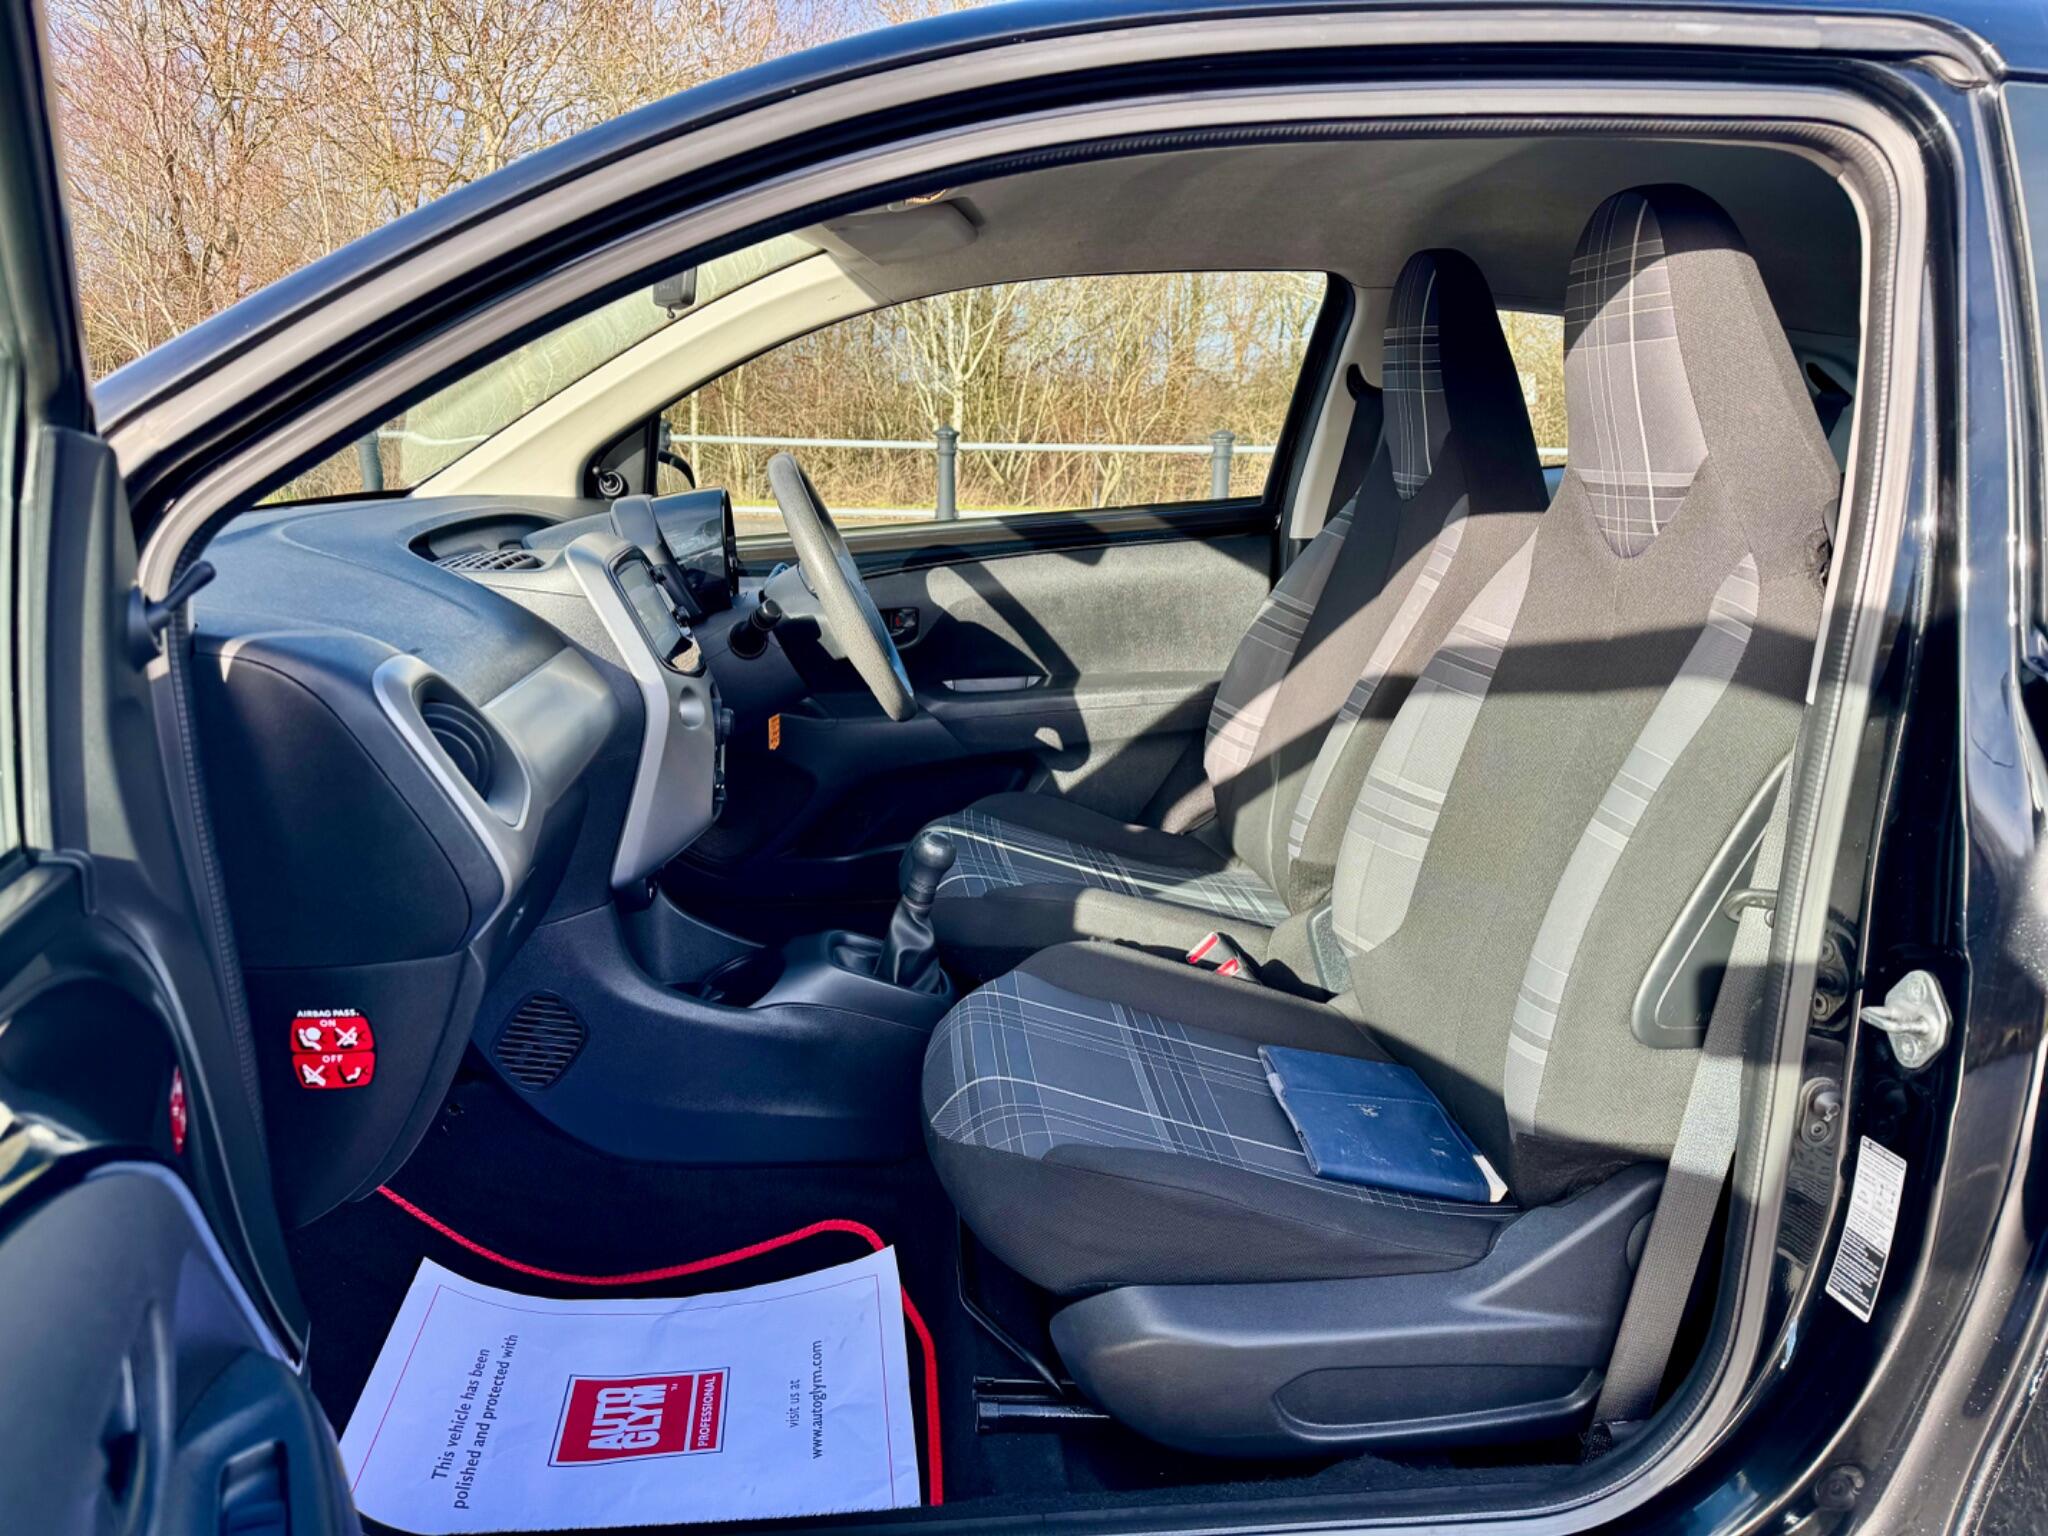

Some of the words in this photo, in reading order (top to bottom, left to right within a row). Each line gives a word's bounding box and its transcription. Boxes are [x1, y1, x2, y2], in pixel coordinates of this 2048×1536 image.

[297, 1009, 331, 1018] AIRBAG
[332, 1008, 360, 1017] PASS.
[319, 1019, 336, 1027] ON
[322, 1054, 343, 1063] OFF
[468, 1348, 490, 1377] been
[460, 1378, 480, 1400] has
[790, 1379, 800, 1390] at
[790, 1393, 800, 1404] us
[697, 1376, 716, 1447] PROFESSIONAL
[808, 1340, 827, 1460] www.autoglym.com
[447, 1403, 471, 1447] vehicle
[453, 1449, 482, 1510] polished
[474, 1422, 491, 1447] and
[483, 1360, 510, 1420] protected
[502, 1334, 519, 1358] with
[587, 1387, 632, 1450] AUTO
[620, 1384, 667, 1449] GLYM
[785, 1406, 800, 1428] visit
[431, 1450, 455, 1479] This
